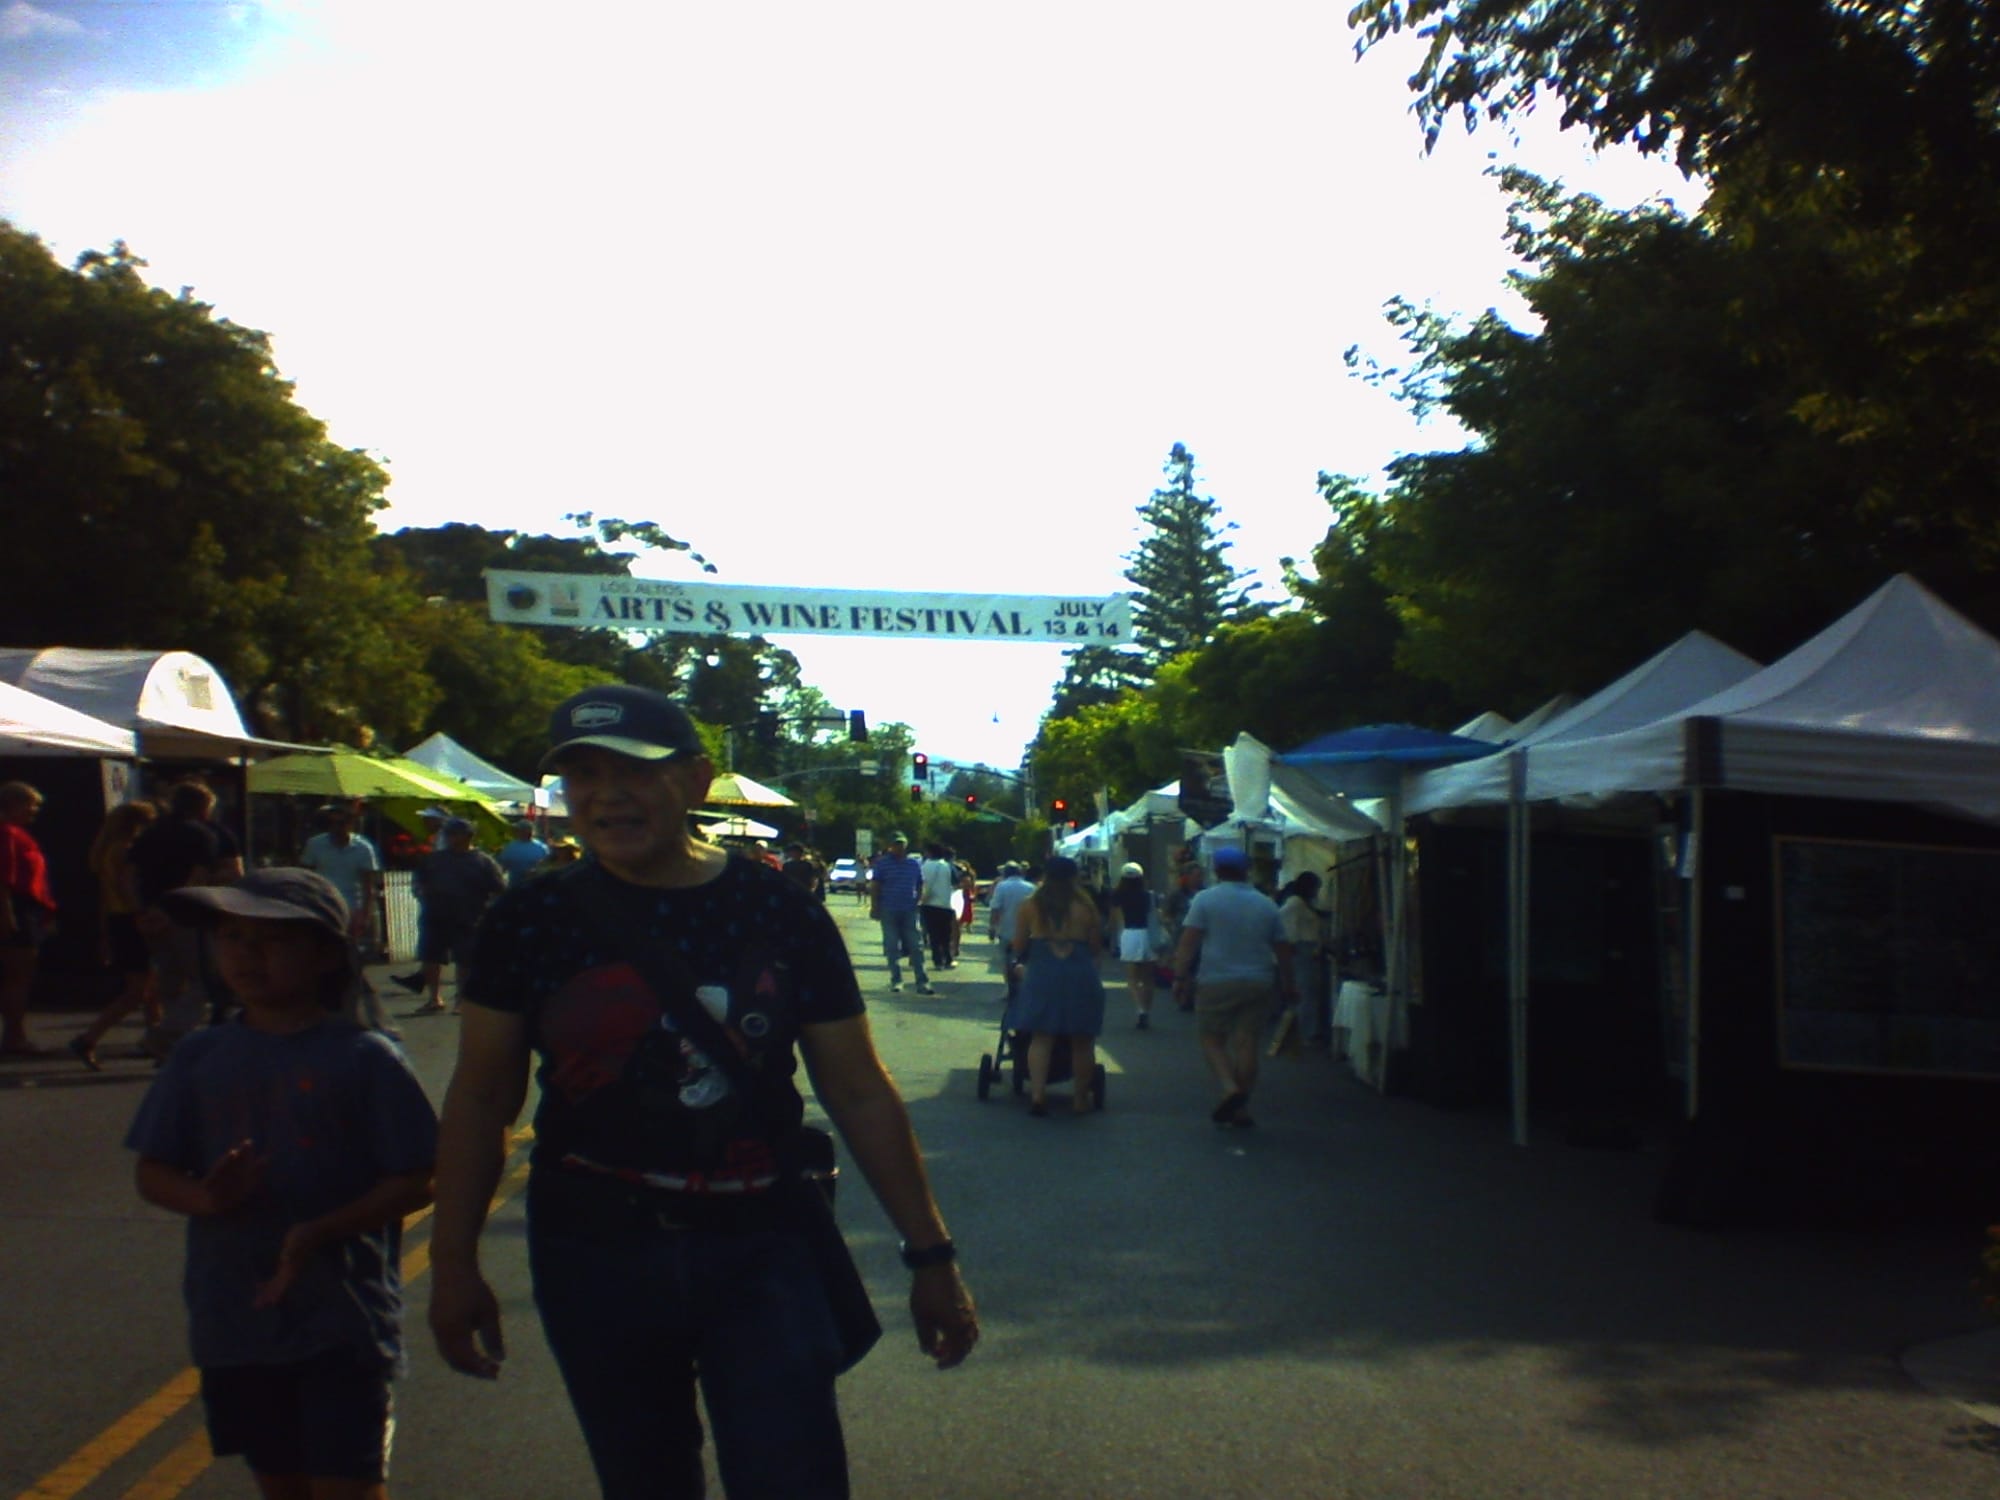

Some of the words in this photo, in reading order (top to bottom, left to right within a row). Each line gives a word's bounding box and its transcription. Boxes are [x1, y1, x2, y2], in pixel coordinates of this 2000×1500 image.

[592, 595, 695, 622] ARTS
[704, 600, 731, 631] &
[741, 601, 841, 630] WINE
[850, 604, 1033, 636] FESTIVAL
[1054, 601, 1105, 618] JULY
[1043, 619, 1067, 636] 13
[1073, 621, 1090, 637] &
[1098, 621, 1120, 638] 14
